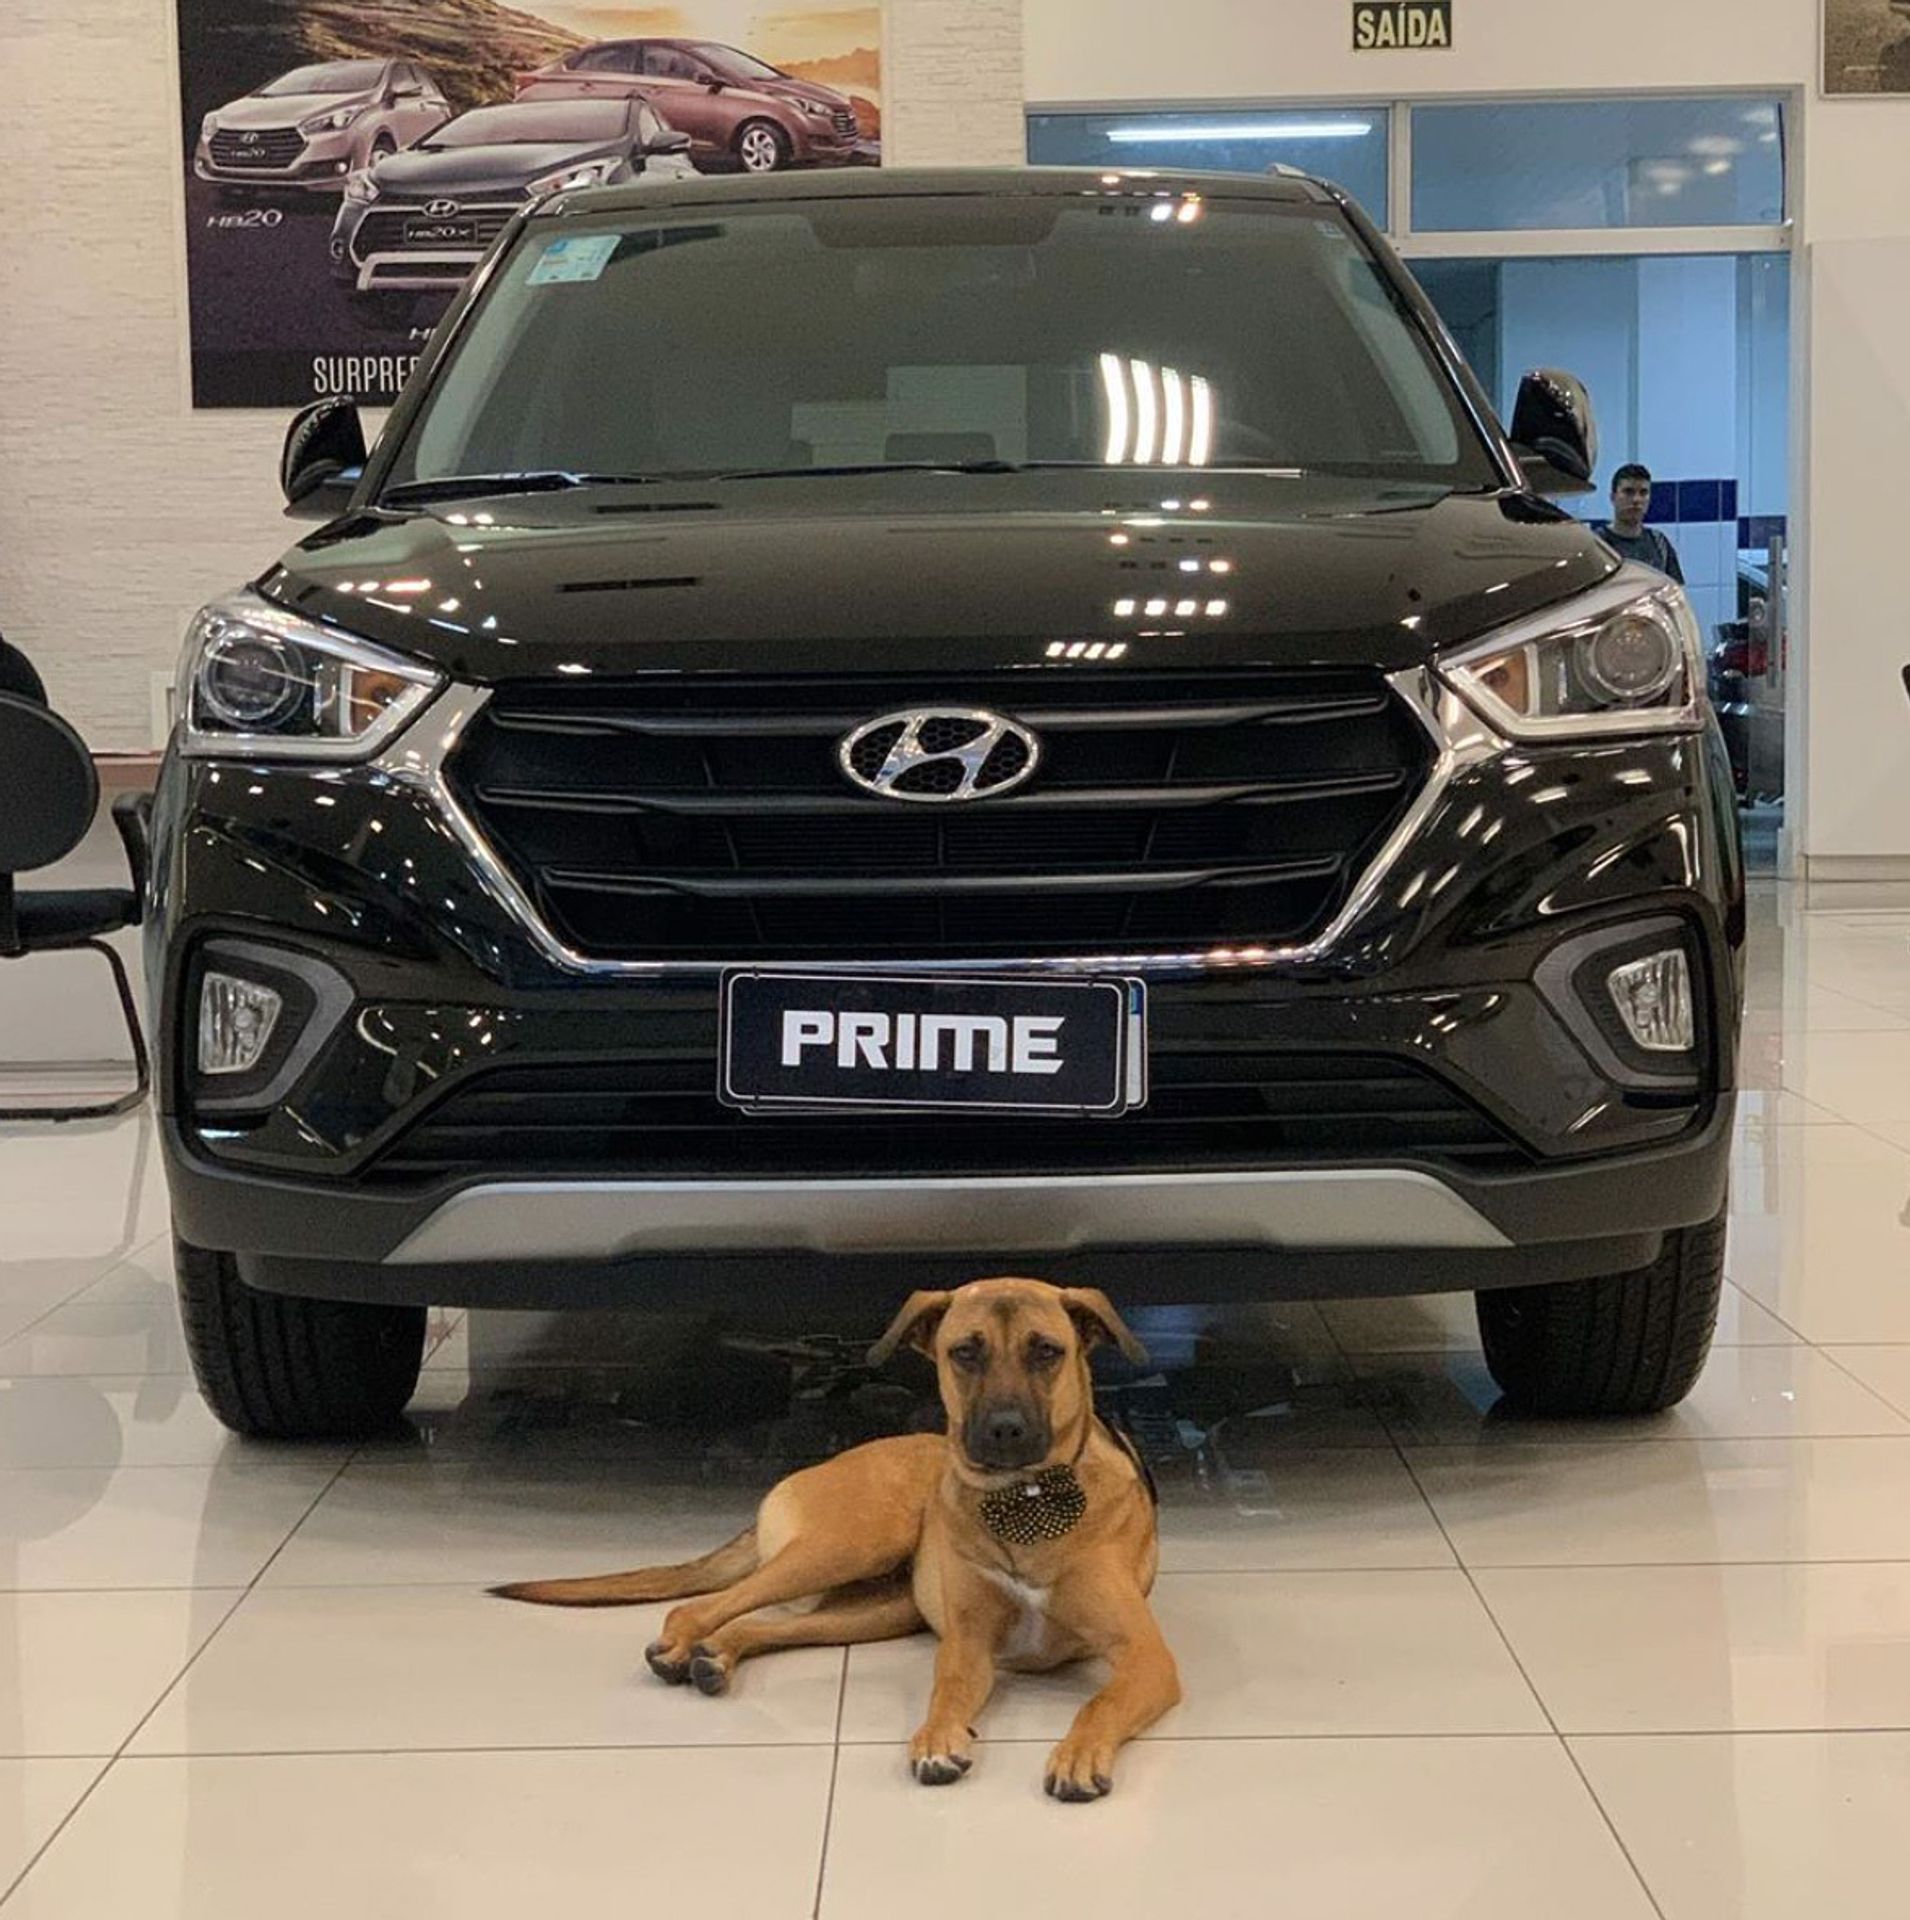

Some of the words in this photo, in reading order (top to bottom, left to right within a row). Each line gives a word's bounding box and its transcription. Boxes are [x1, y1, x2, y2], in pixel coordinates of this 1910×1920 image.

[1357, 3, 1447, 48] SAÍDA
[206, 208, 283, 228] HB20
[781, 1010, 1065, 1074] PRIME
